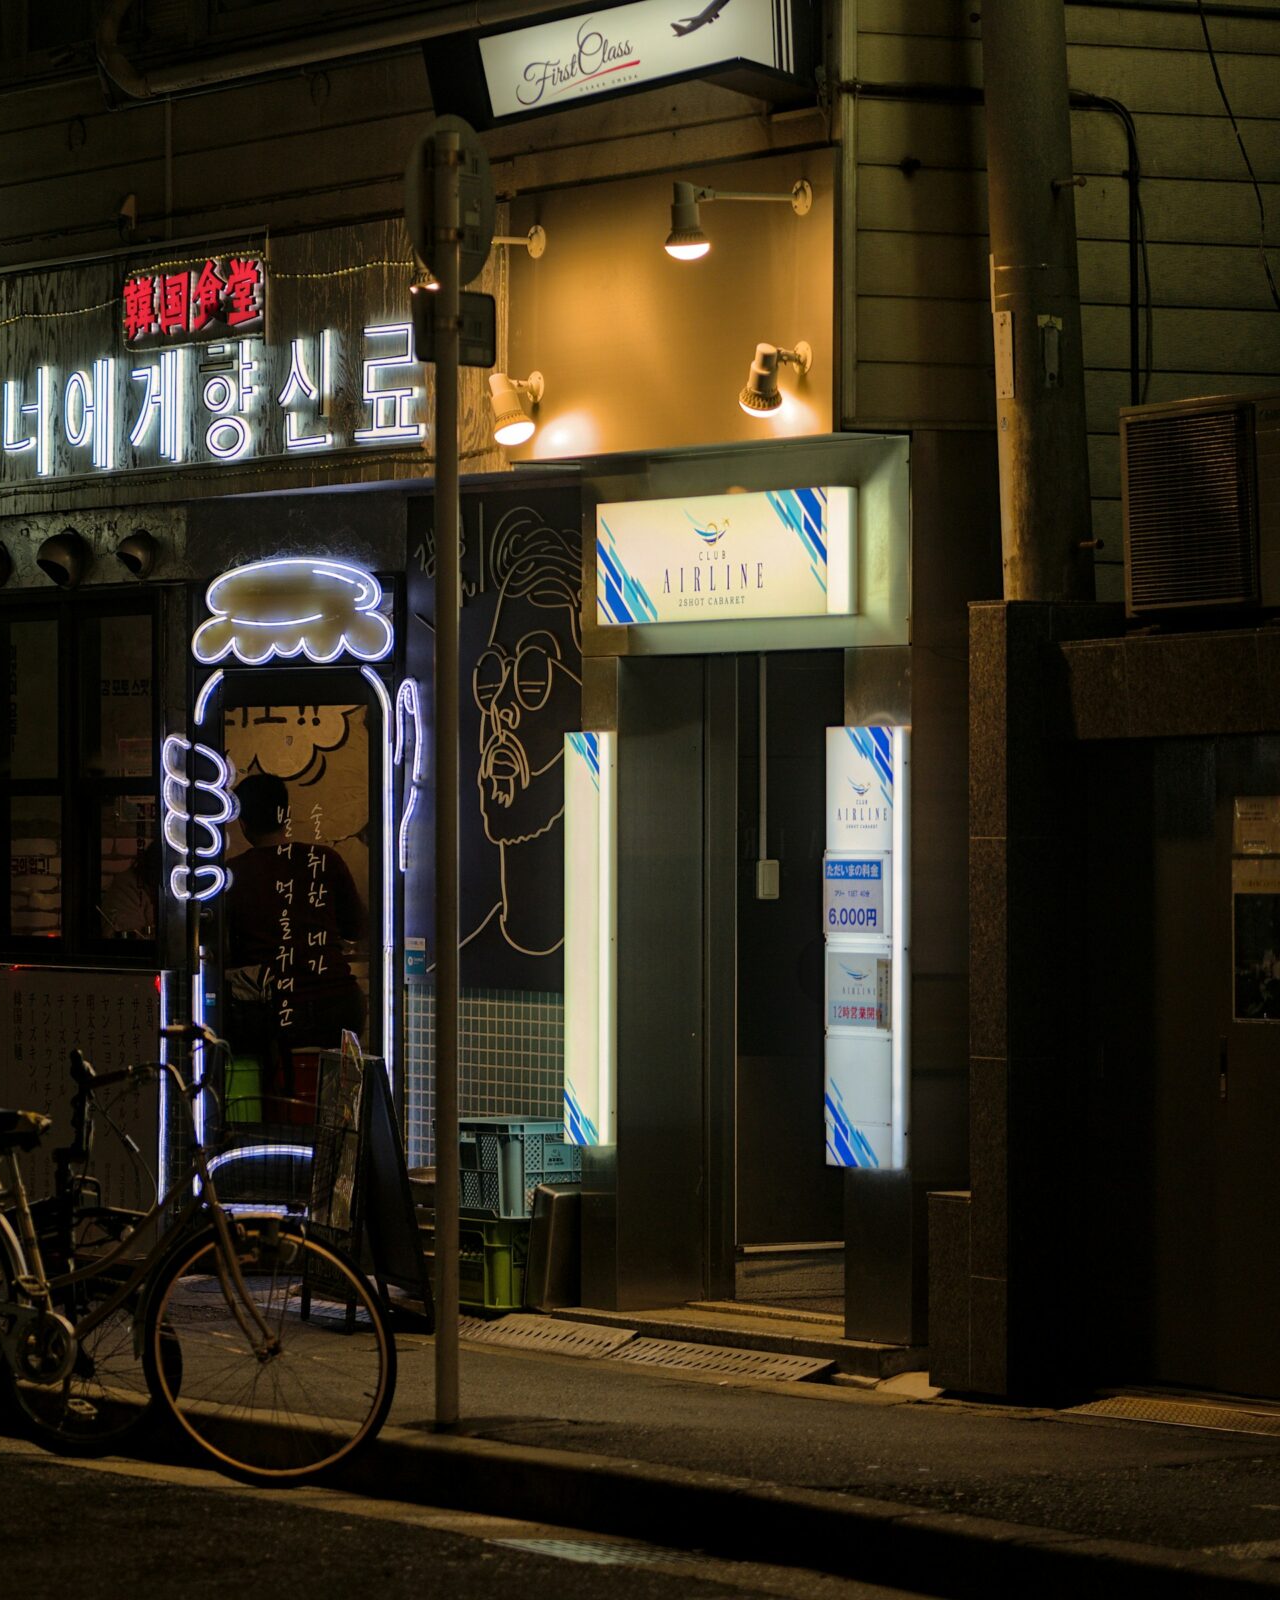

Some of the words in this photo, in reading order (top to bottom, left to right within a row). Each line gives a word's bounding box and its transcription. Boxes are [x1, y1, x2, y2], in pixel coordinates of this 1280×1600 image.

[516, 54, 578, 105] First
[577, 17, 634, 75] Class
[123, 258, 260, 340] 韓国食堂
[699, 550, 727, 561] CLUB
[663, 563, 764, 593] AIRLINE
[678, 597, 705, 607] 2SHOT
[708, 596, 745, 606] CABARET
[838, 807, 888, 821] AIRLINE
[826, 863, 879, 878] ただいまの料金
